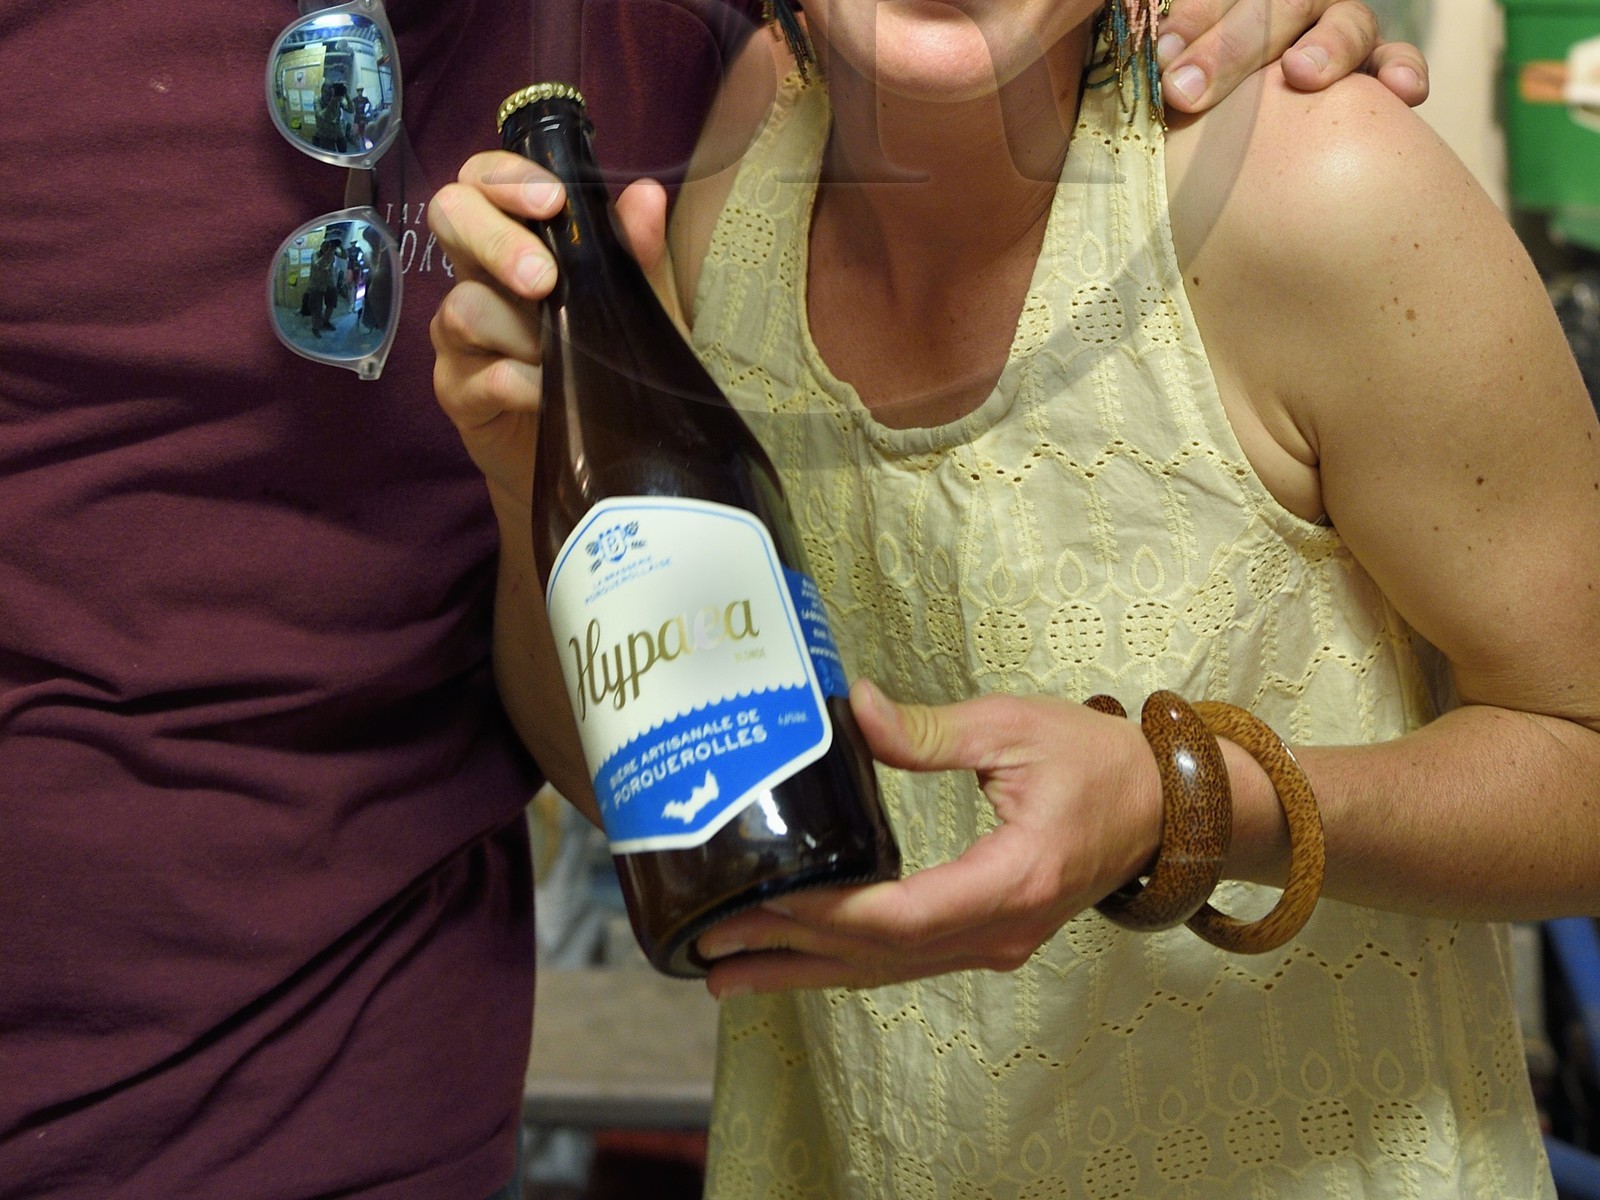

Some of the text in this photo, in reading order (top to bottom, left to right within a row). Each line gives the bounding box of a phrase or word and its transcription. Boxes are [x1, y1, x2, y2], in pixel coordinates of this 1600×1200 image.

[568, 597, 761, 723] Hypaea
[612, 723, 769, 812] PORQUEROLLES
[641, 714, 734, 768] ARTISANALE
[735, 707, 762, 726] DE
